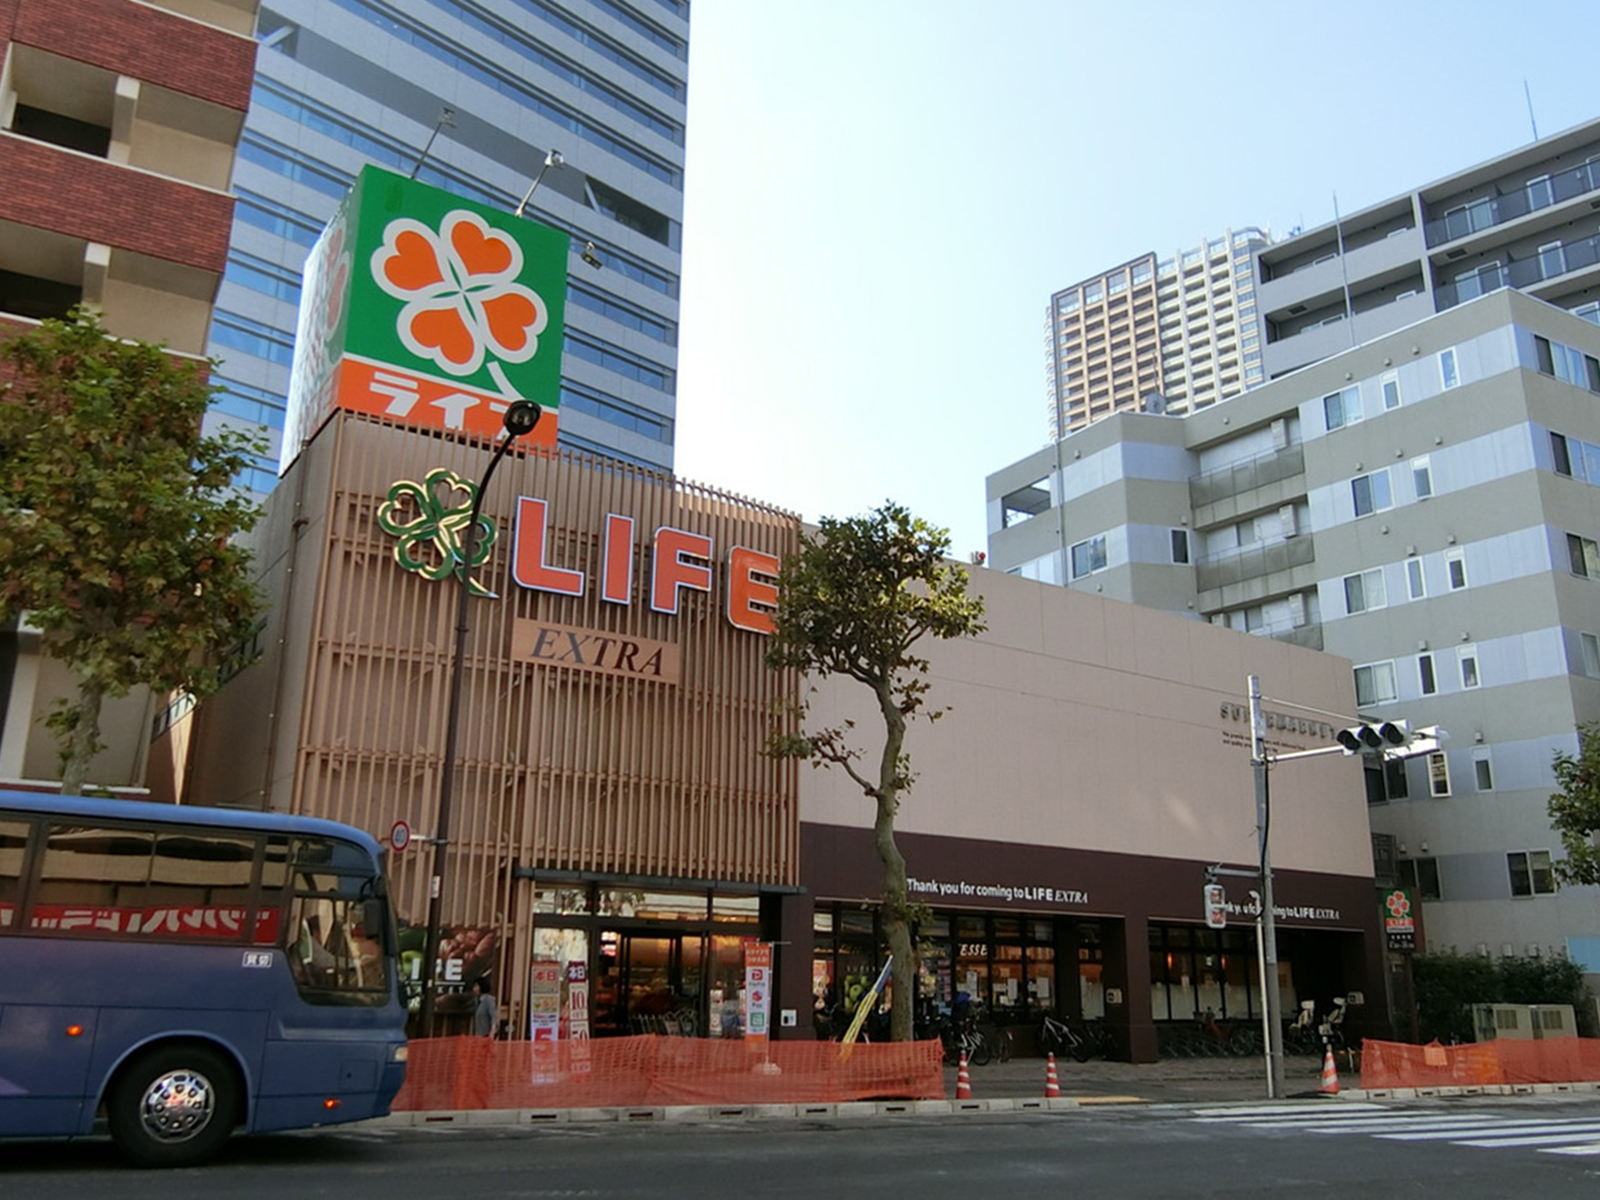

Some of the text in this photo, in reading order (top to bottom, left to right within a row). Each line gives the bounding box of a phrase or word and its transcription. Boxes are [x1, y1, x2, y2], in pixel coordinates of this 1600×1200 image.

[511, 494, 780, 635] LIFE
[530, 628, 665, 677] EXTRA
[906, 878, 1088, 904] Thank you for coming to LIFE EXTRA
[1294, 908, 1315, 919] LIFE
[1316, 908, 1340, 920] EXTRA
[569, 966, 585, 981] 本日
[572, 991, 585, 1010] 10
